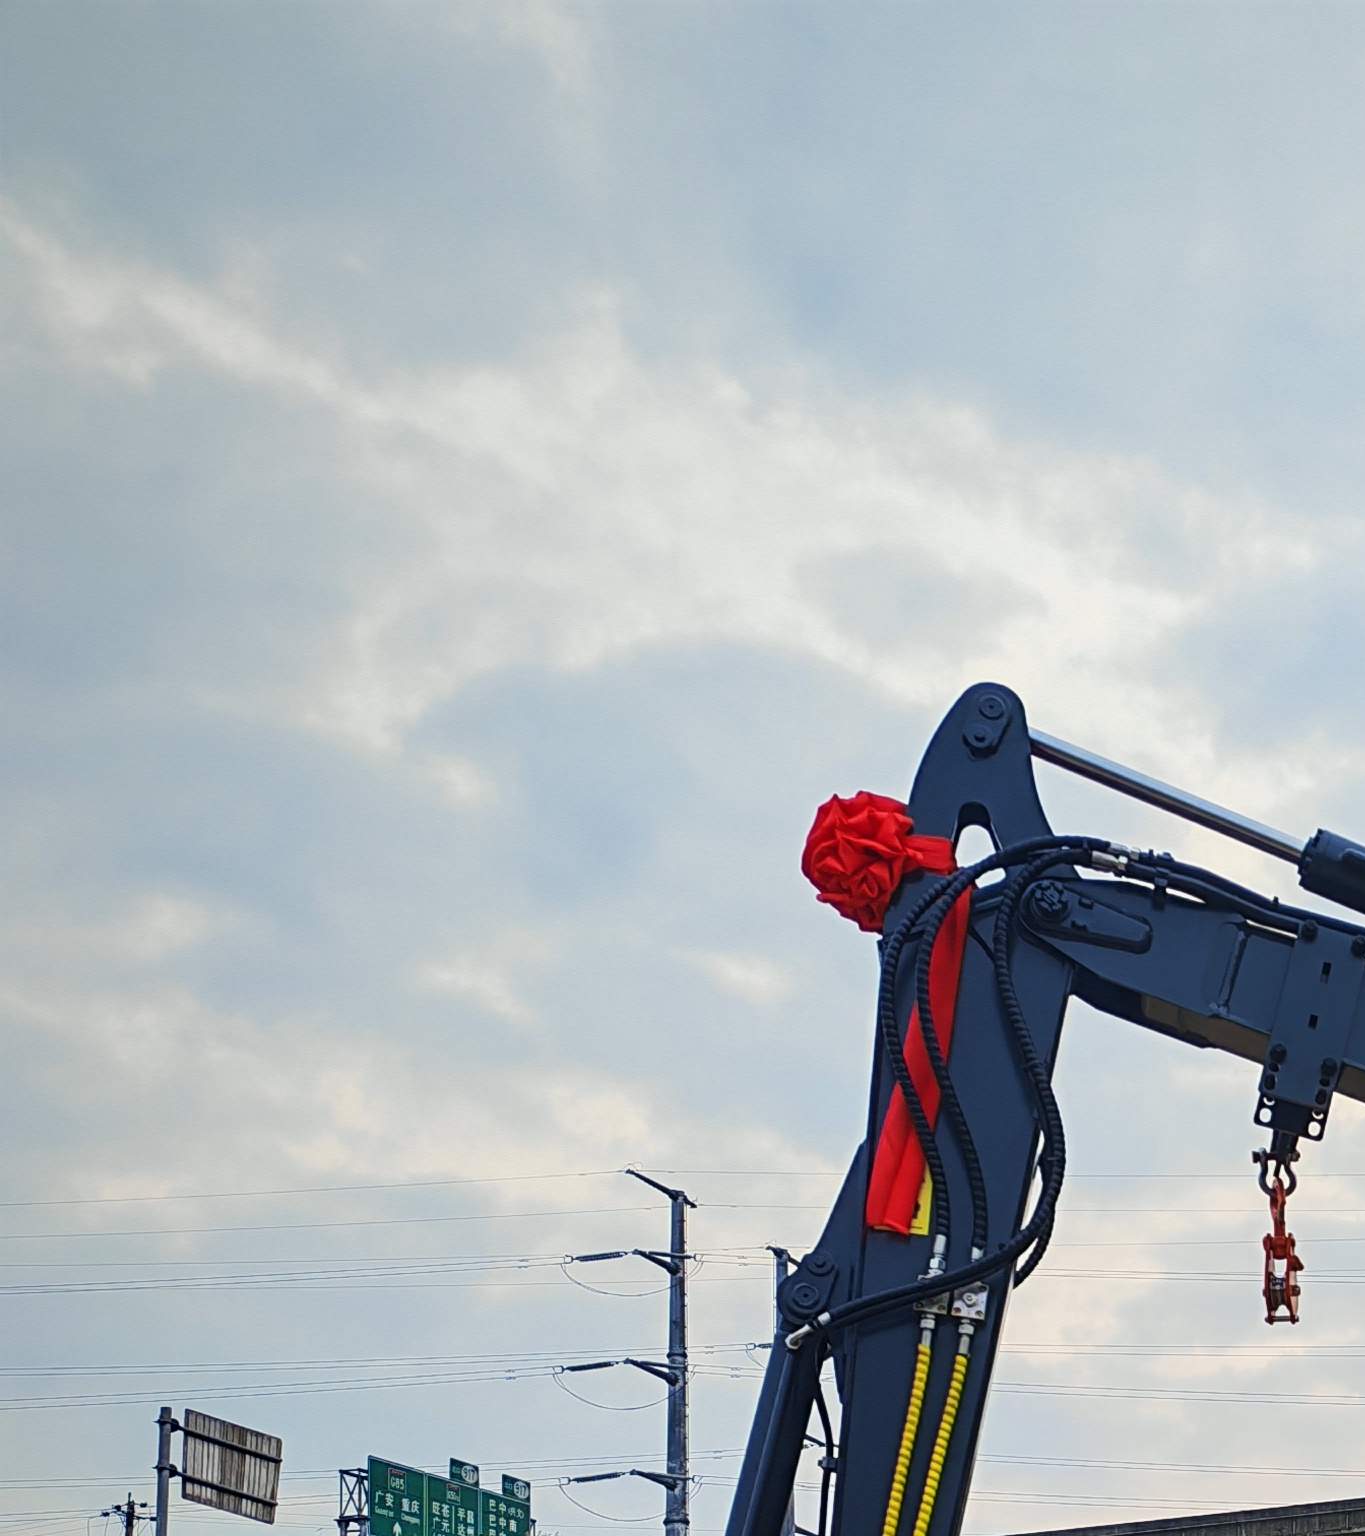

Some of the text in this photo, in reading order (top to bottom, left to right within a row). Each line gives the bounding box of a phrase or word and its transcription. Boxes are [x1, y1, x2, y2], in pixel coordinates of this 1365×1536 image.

[375, 1490, 420, 1514] 广安 重庆
[432, 1517, 450, 1533] 广元
